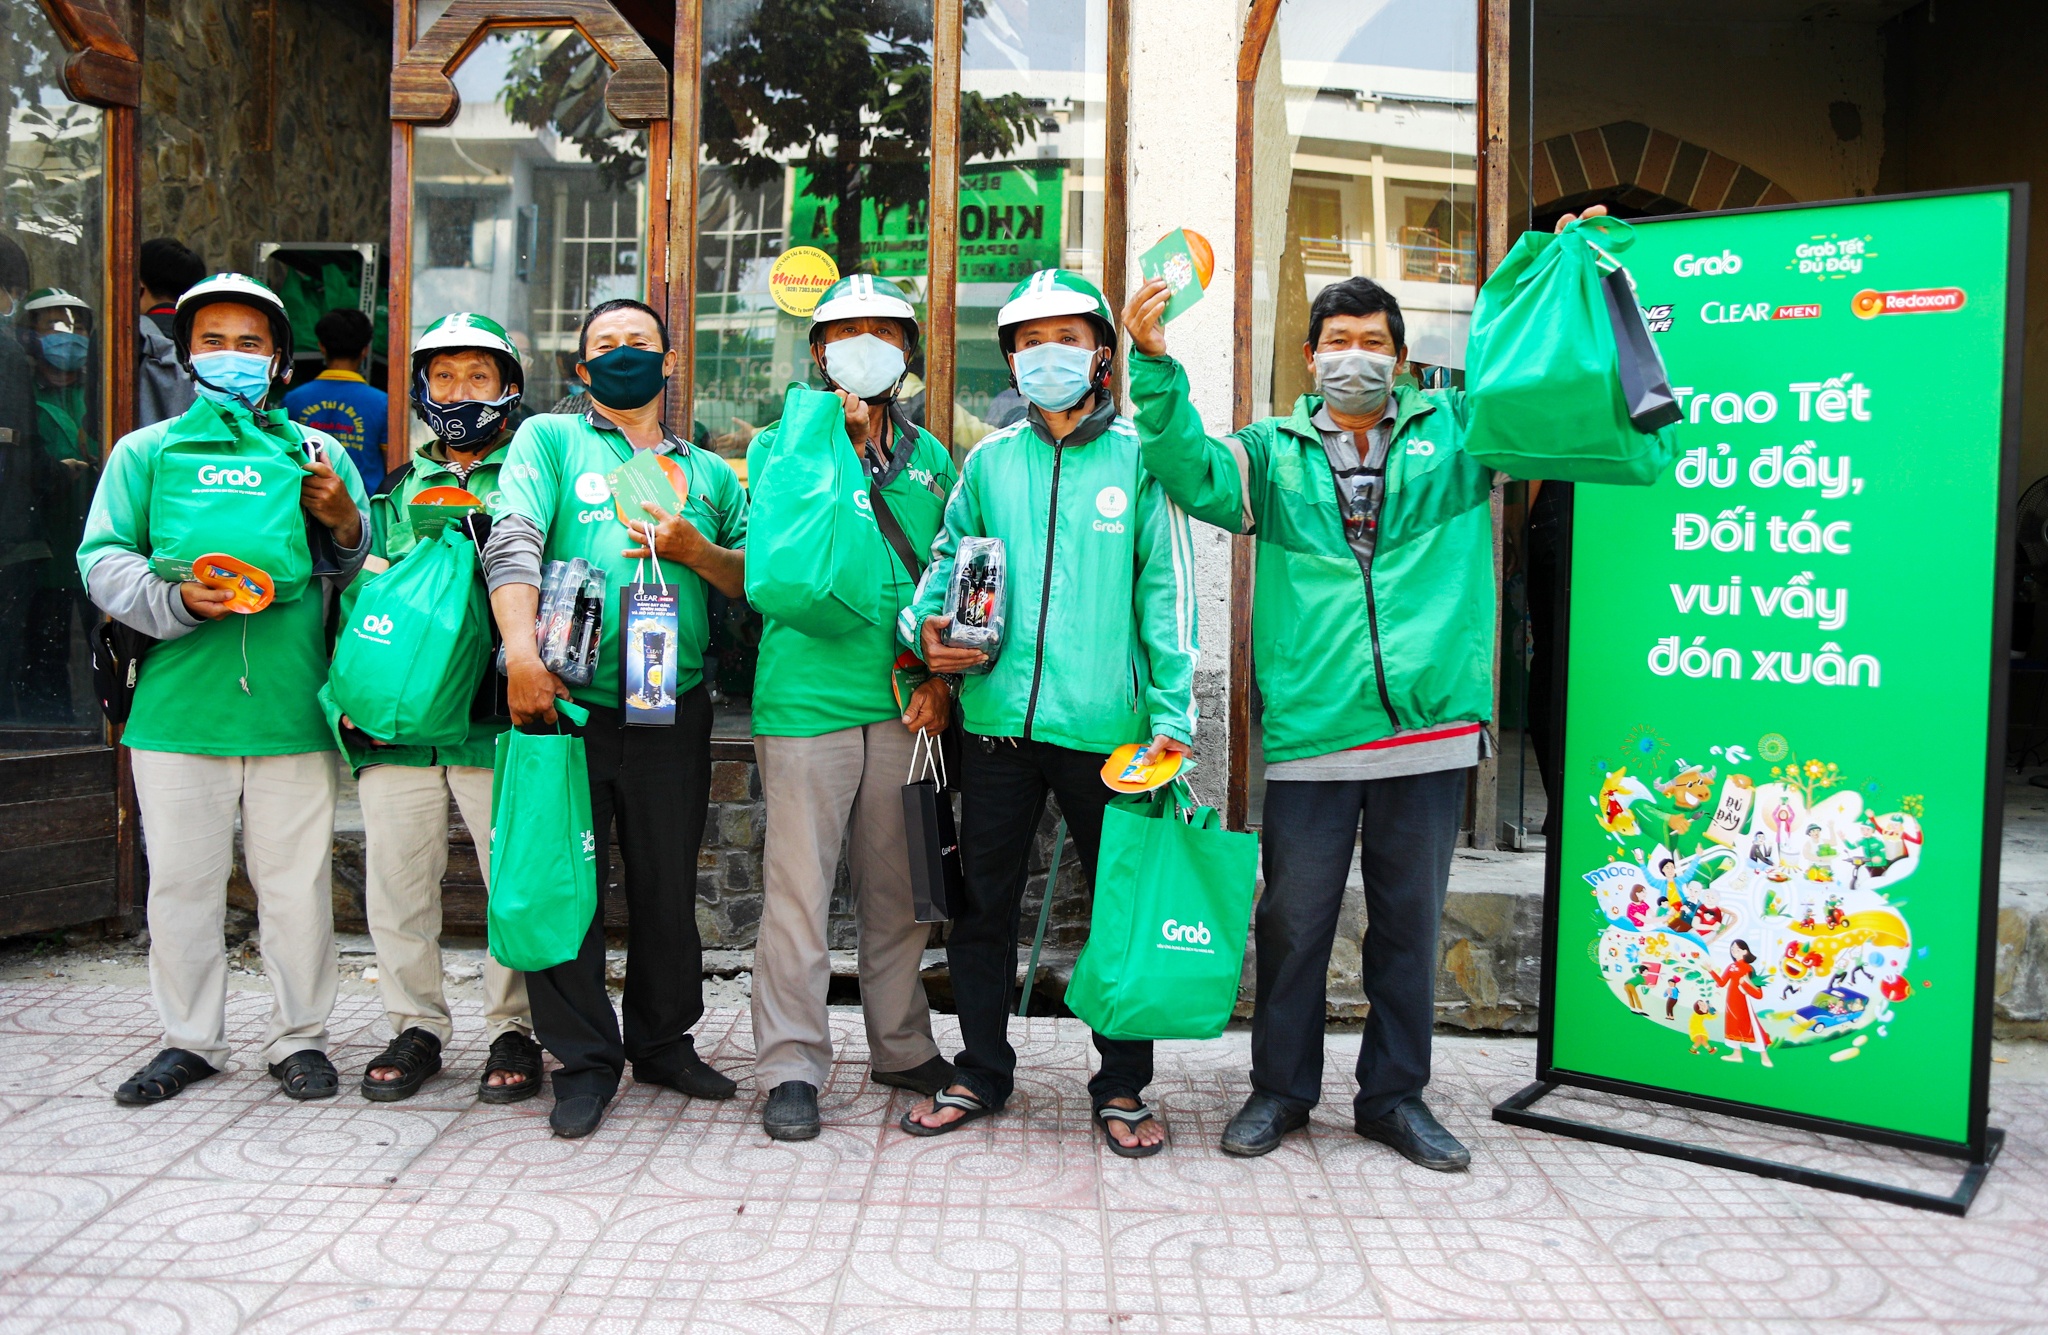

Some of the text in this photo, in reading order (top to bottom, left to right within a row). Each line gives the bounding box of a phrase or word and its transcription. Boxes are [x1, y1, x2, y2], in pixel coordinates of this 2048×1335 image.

[1795, 237, 1865, 259] Grab Tết
[1673, 249, 1742, 278] Grab
[1798, 256, 1863, 274] Đủ Đầy
[772, 272, 809, 287] Minh
[1885, 291, 1956, 310] Redoxon
[1700, 301, 1818, 324] CLEAR MEN
[1649, 318, 1674, 333] AFÉ
[1672, 372, 1872, 424] Trao Tết
[475, 410, 501, 429] adidas
[198, 464, 262, 488] Grab
[1674, 439, 1865, 499] đủ đầy,
[578, 507, 615, 524] Grab
[1092, 519, 1125, 534] Grab
[1671, 505, 1852, 556] Đối tác
[634, 593, 658, 602] CLEAR
[1669, 571, 1849, 631] vui vầy
[363, 614, 394, 636] ab
[1647, 635, 1881, 688] đón xuân
[1585, 865, 1636, 886] moca
[1162, 919, 1211, 945] Grab
